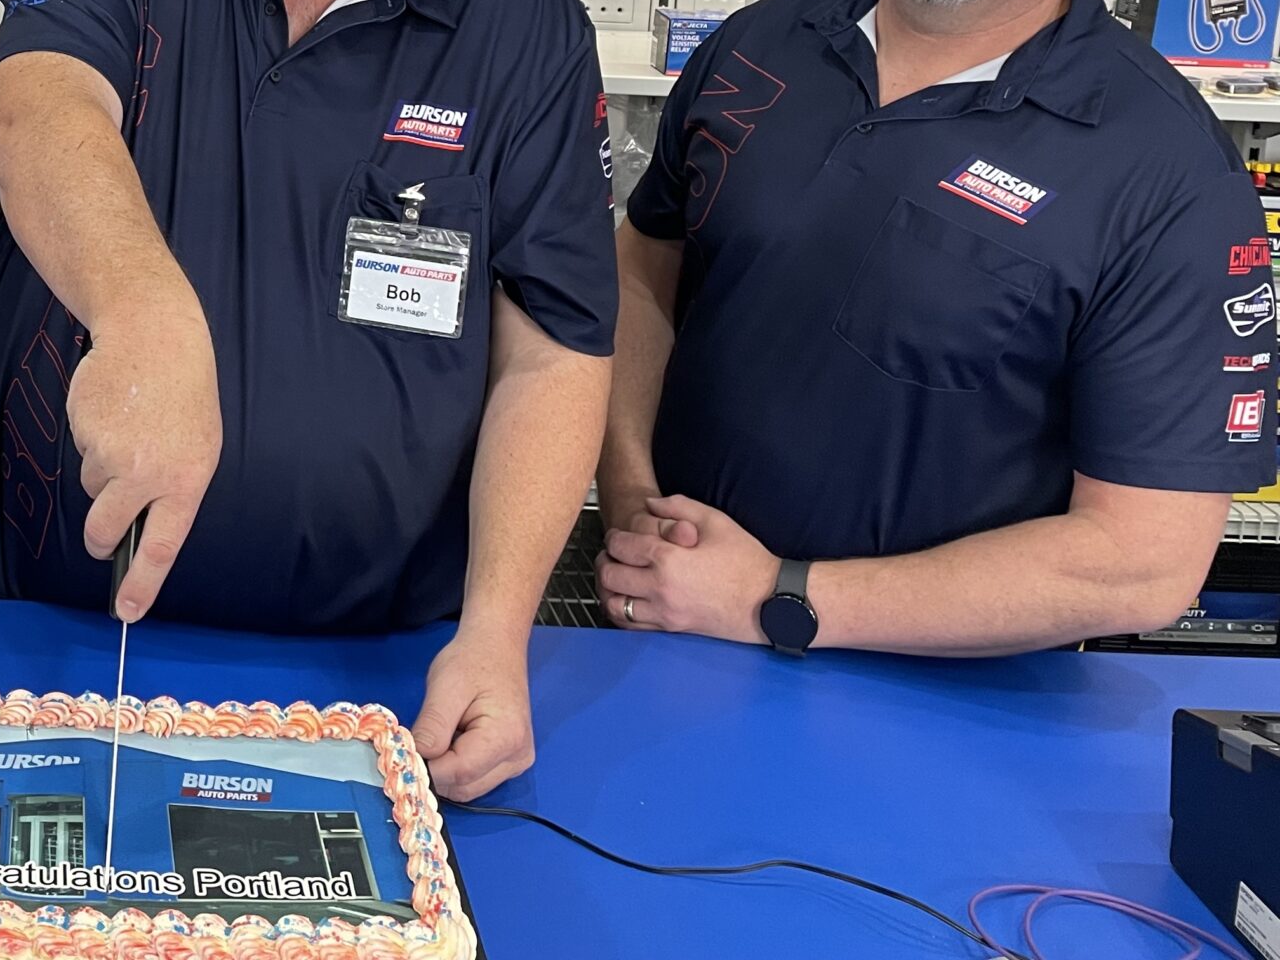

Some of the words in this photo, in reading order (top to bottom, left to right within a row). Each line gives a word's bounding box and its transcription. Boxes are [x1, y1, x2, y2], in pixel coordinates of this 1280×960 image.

[672, 21, 708, 29] PROJECTA
[400, 104, 468, 127] BURSON
[400, 120, 427, 132] AUTO
[426, 124, 457, 137] PARTS
[967, 160, 1047, 203] BURSON
[962, 175, 992, 192] AUTO
[991, 188, 1026, 210] PARTS
[355, 258, 400, 273] BURSON
[404, 267, 426, 277] AUTO
[427, 271, 453, 281] PARTS
[386, 284, 421, 303] Bob
[376, 303, 395, 312] Store
[396, 307, 428, 318] Manager
[1233, 301, 1271, 313] Summit
[182, 772, 272, 793] BURSON
[197, 790, 225, 799] AUTO
[226, 791, 258, 801] PARTS
[193, 869, 357, 900] Portland
